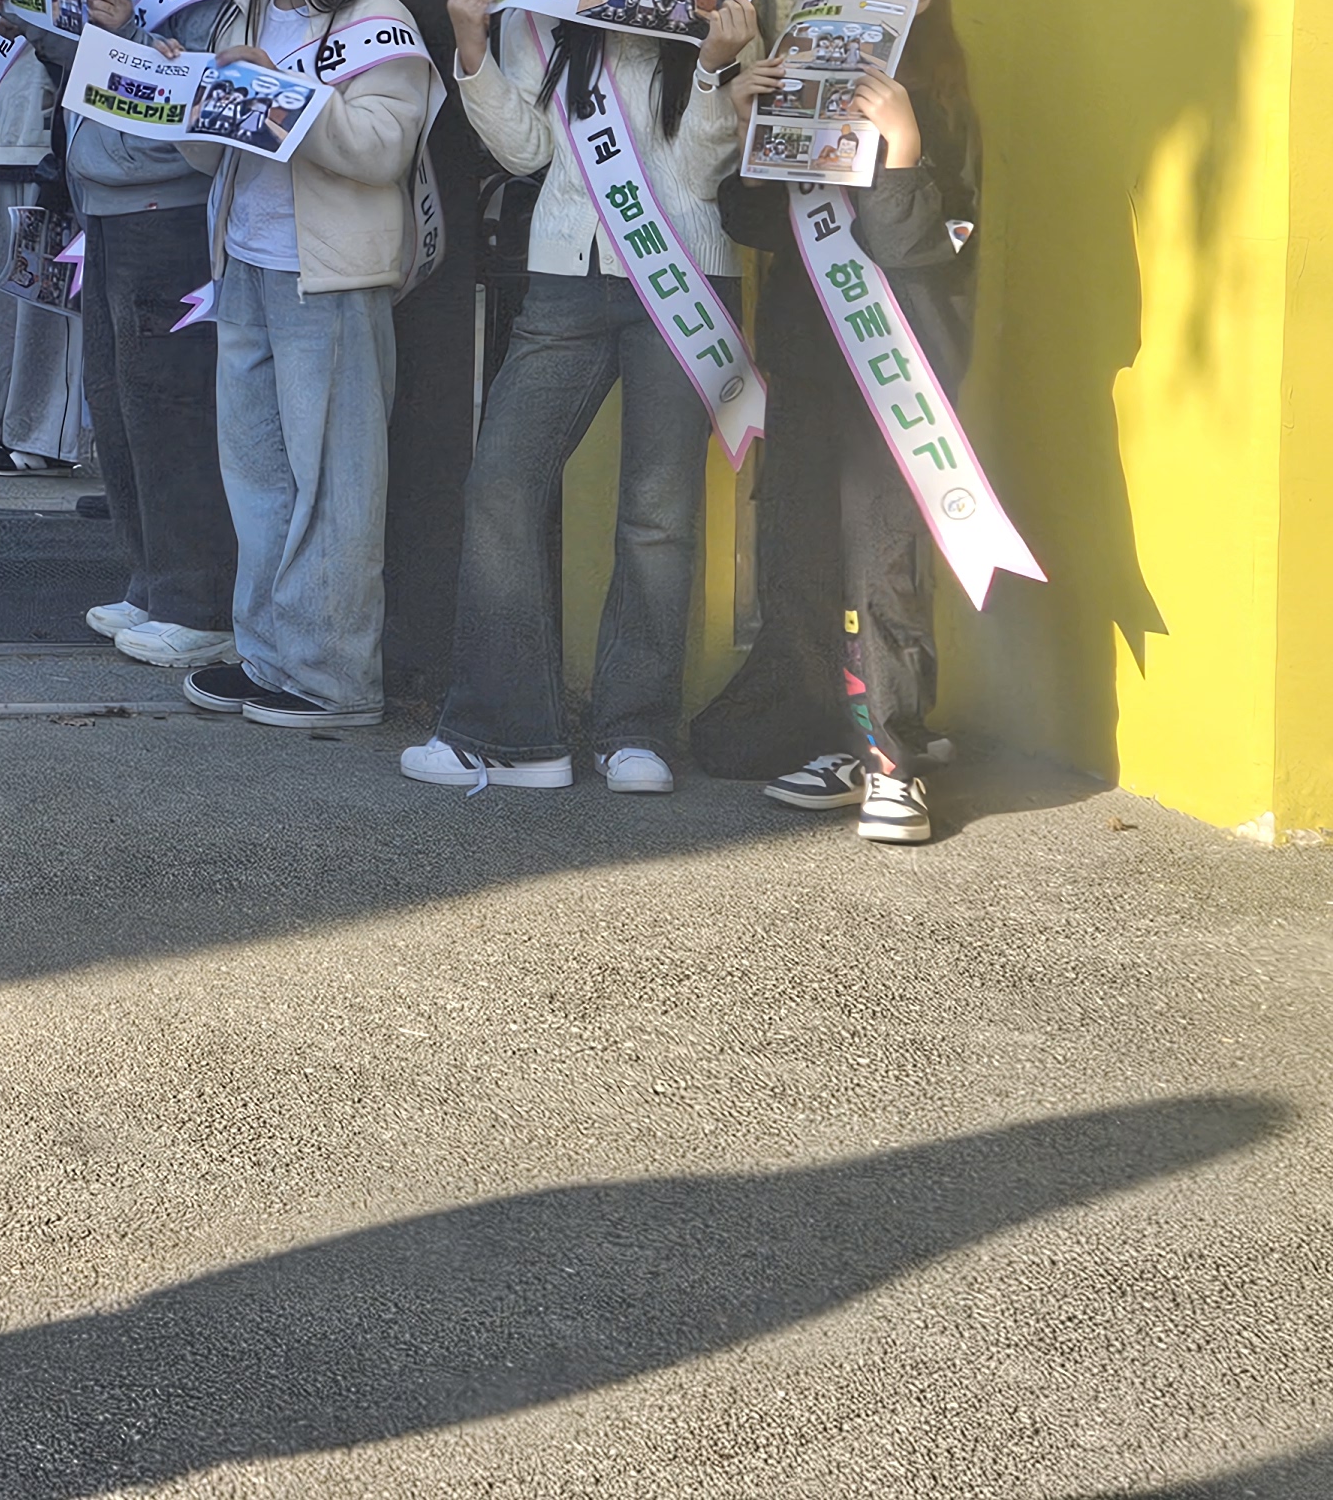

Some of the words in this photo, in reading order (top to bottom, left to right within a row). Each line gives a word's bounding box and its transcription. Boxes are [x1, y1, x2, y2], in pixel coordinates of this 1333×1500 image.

[108, 48, 129, 65] 우리
[132, 56, 153, 72] 모두
[605, 179, 735, 369] 함께다니기
[824, 258, 958, 472] 함께다니기
